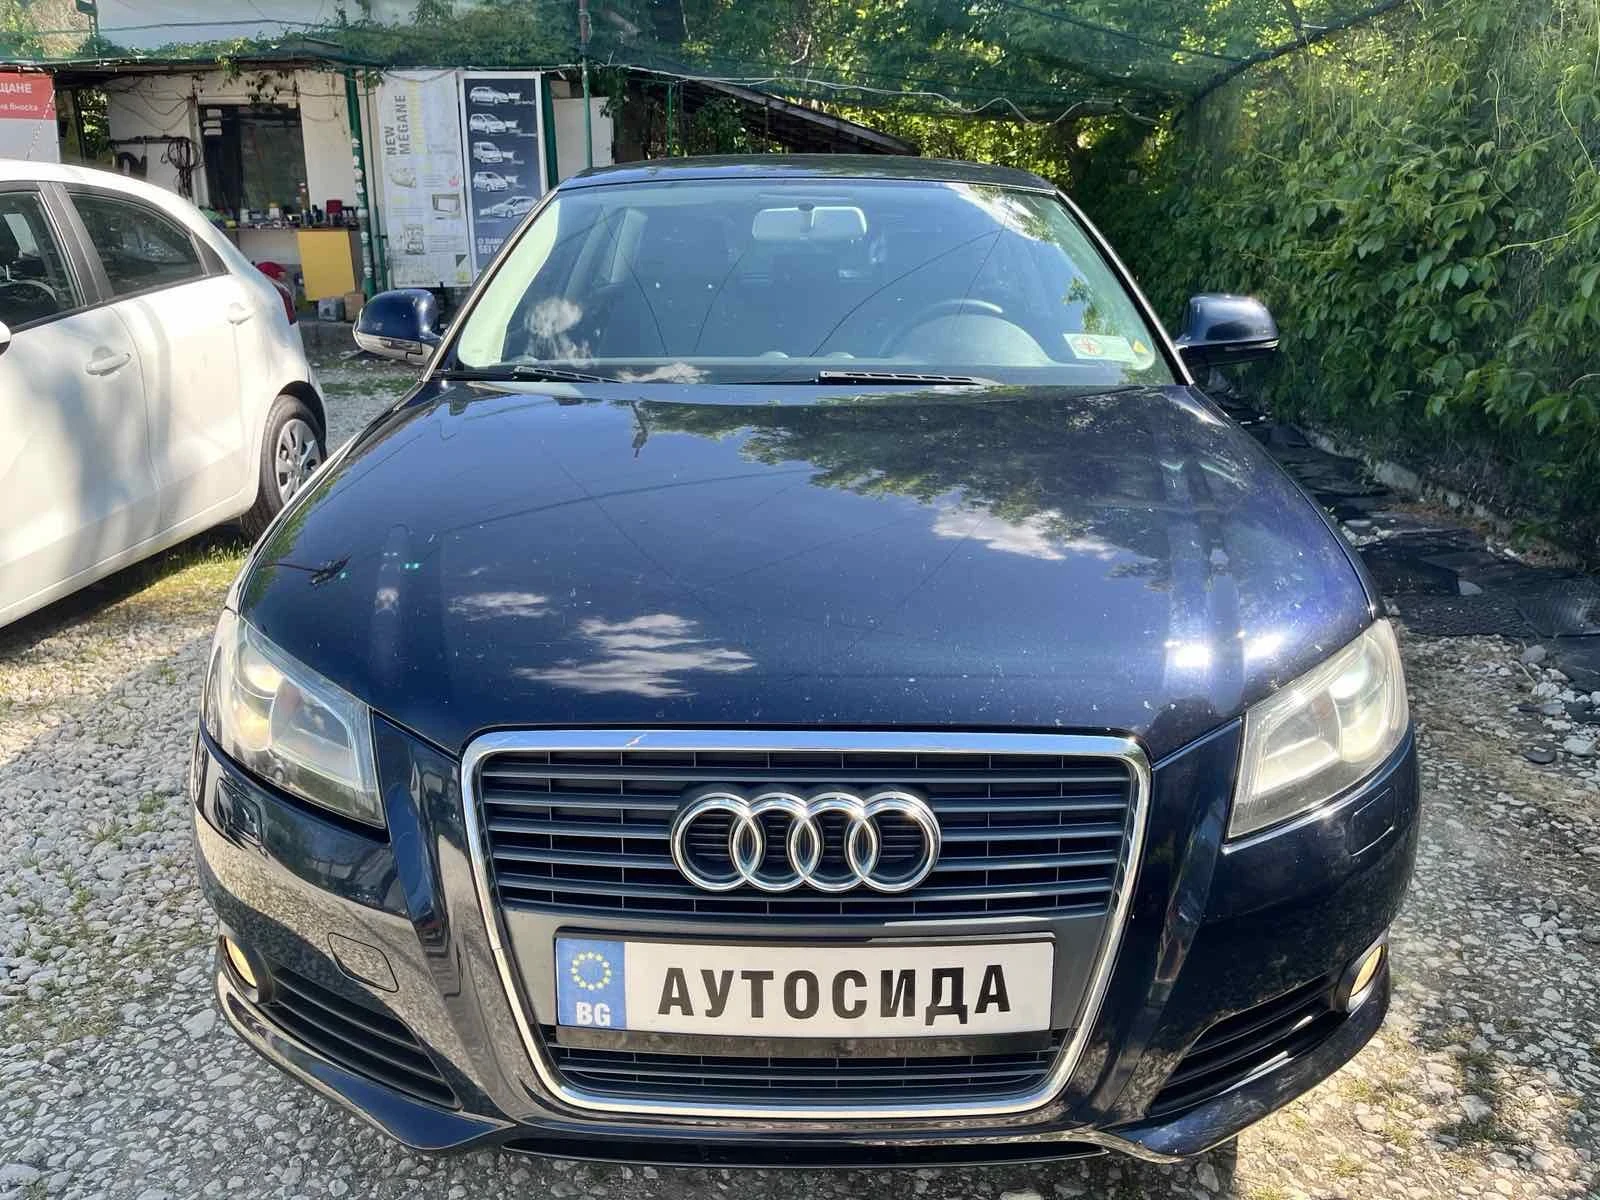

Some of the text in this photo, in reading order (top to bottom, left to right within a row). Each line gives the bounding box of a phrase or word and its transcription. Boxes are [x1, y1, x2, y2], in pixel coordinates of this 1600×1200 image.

[384, 126, 396, 155] NEW
[658, 965, 1010, 1026] АУТОСИДА
[576, 1001, 610, 1026] BG
